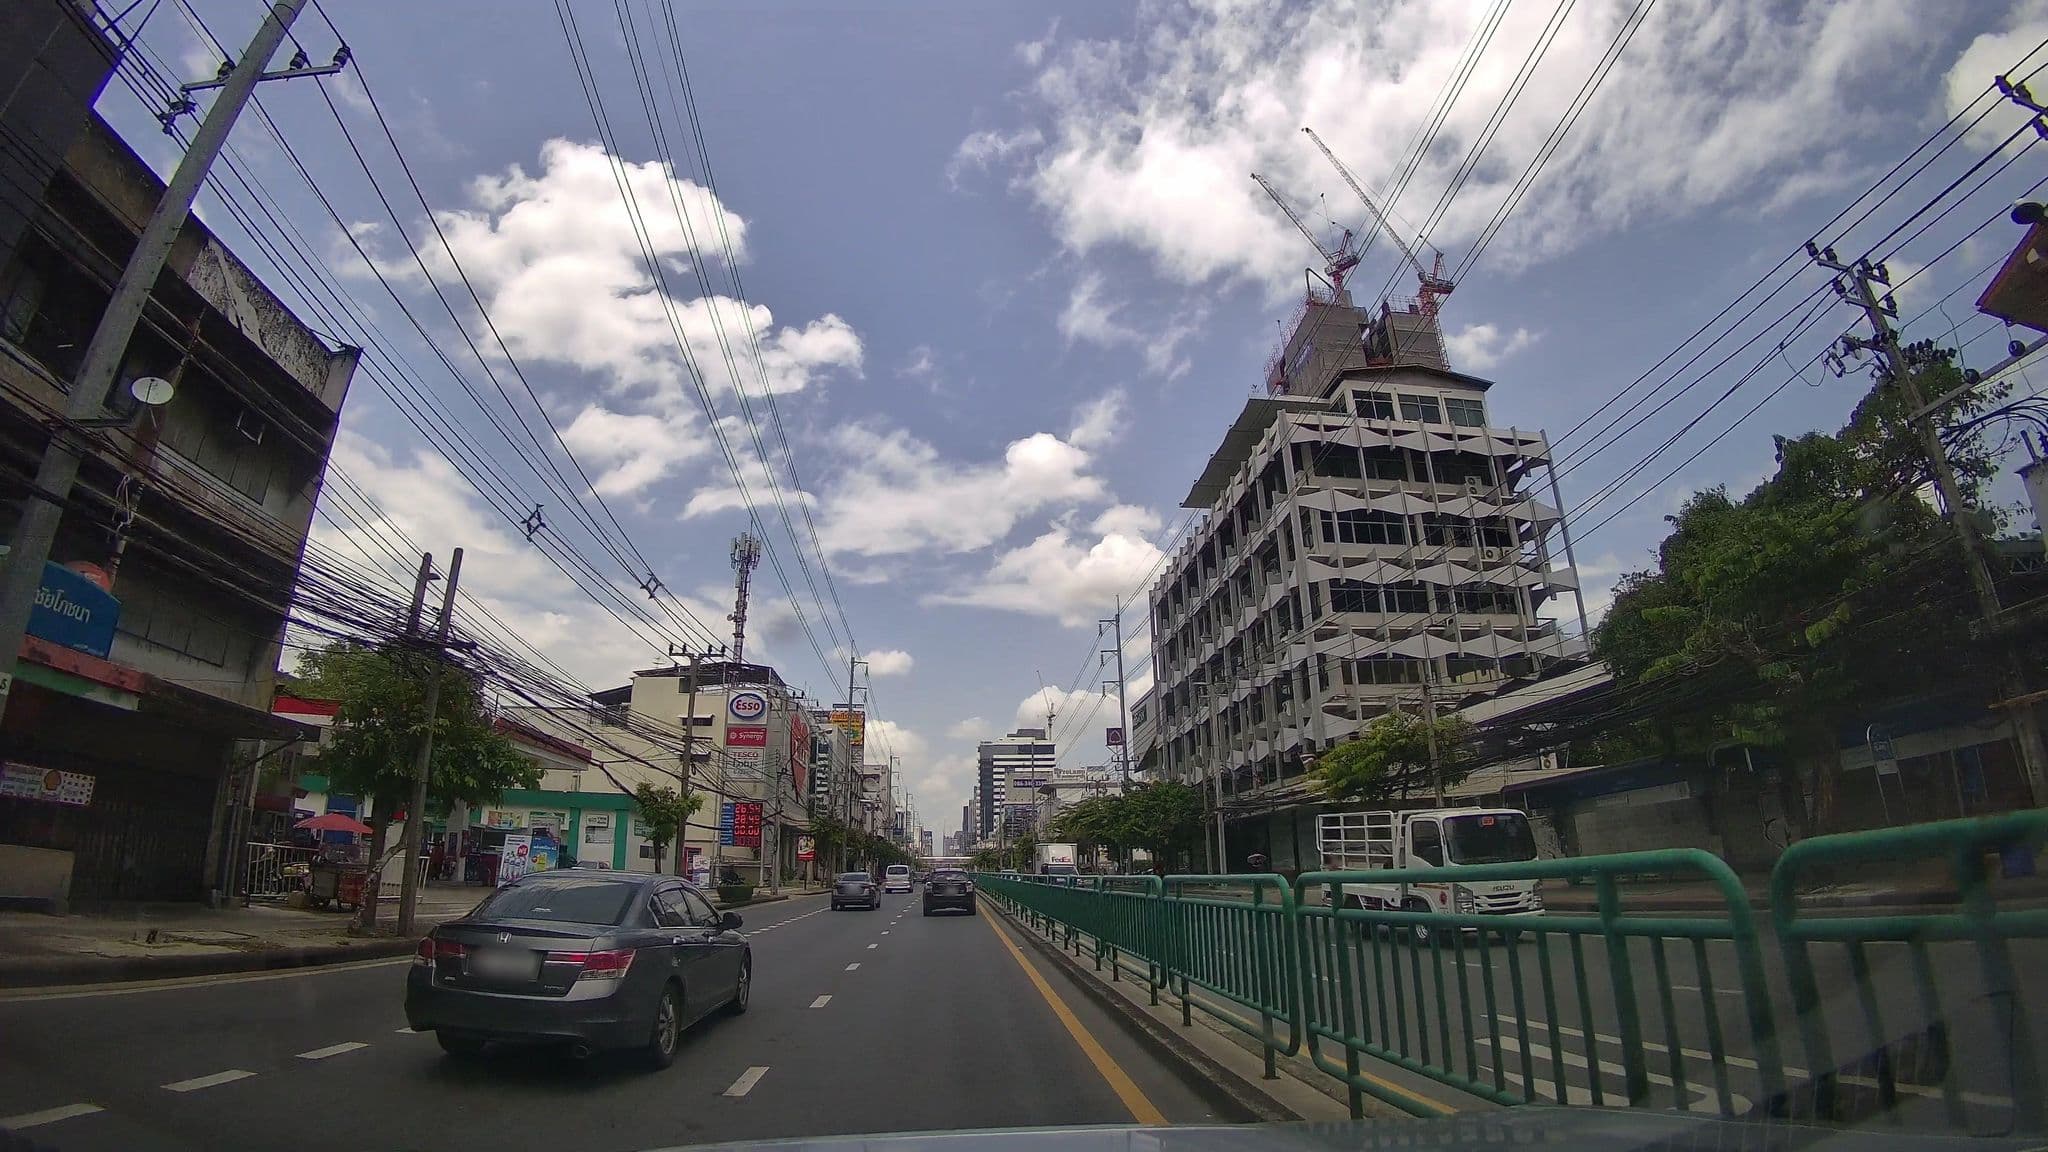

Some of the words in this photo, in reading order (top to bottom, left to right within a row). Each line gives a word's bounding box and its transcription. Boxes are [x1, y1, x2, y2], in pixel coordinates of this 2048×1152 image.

[735, 699, 760, 711] Esso
[738, 731, 764, 741] Synergy
[1492, 884, 1515, 892] ISUZU
